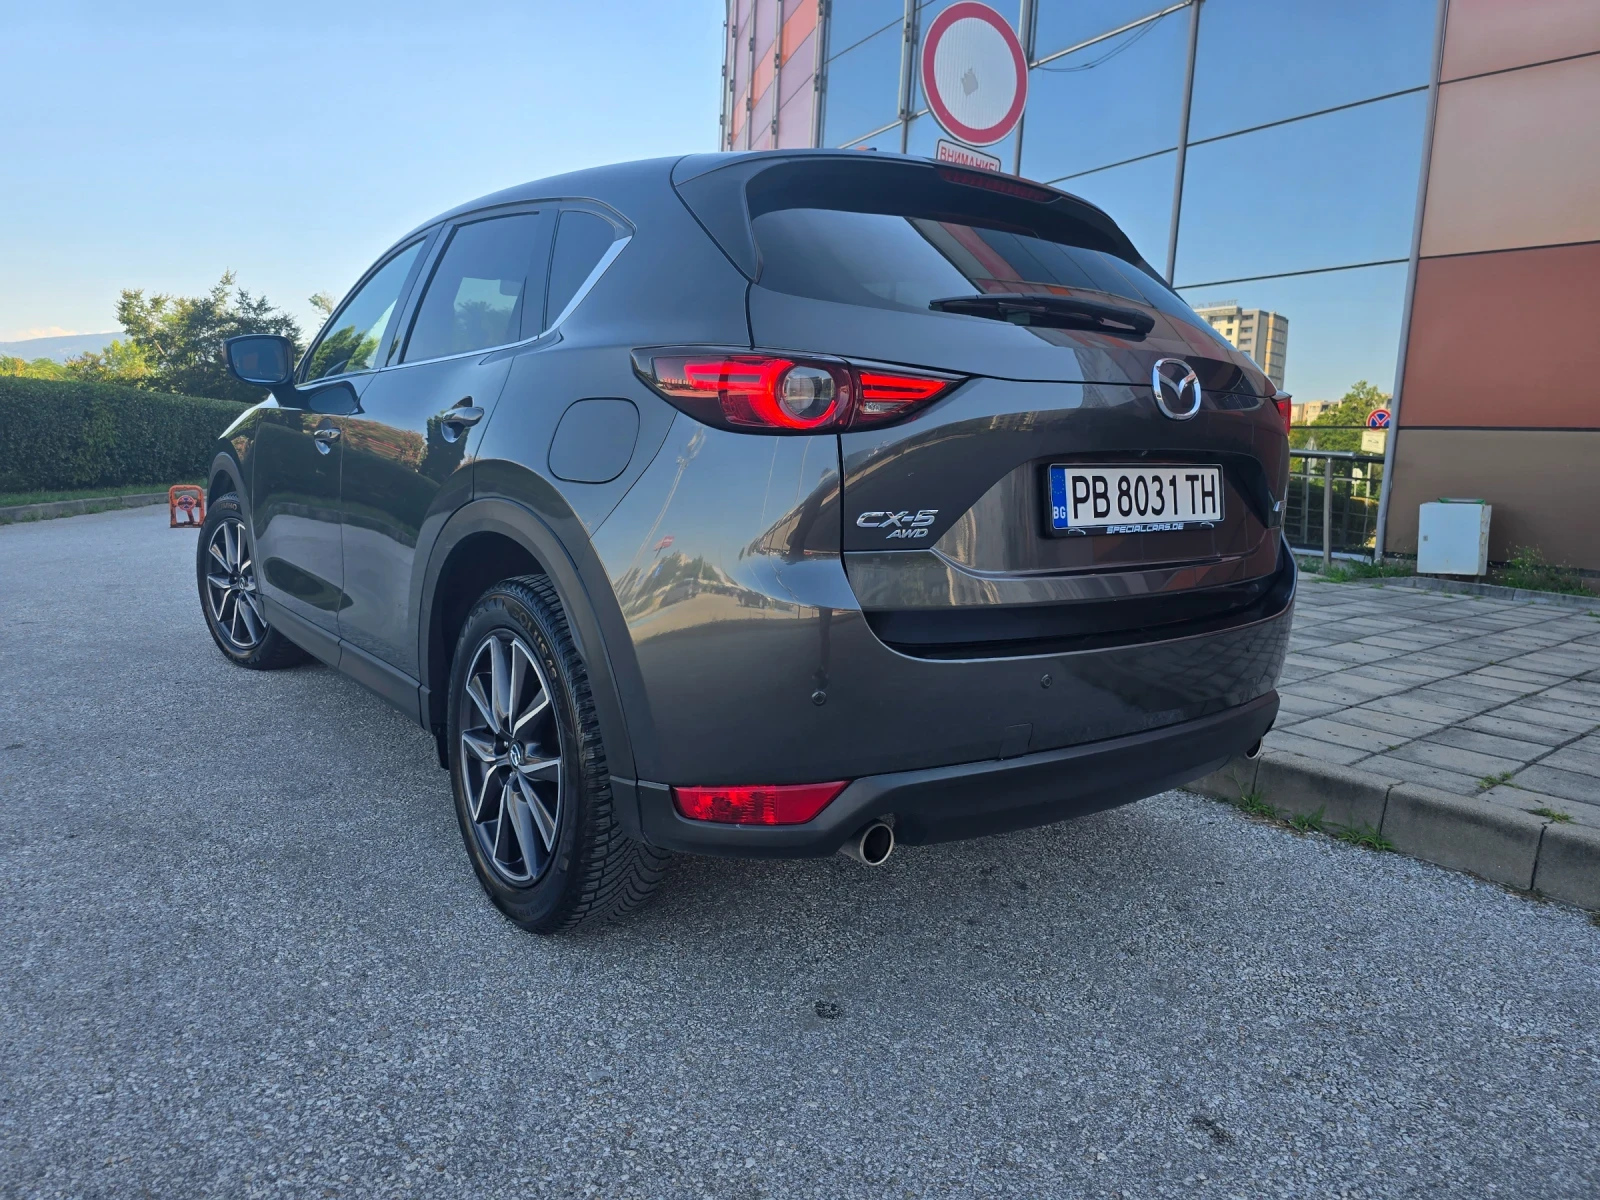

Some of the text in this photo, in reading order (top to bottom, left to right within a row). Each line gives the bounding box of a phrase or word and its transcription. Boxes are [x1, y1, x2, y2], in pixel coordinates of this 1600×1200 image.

[1071, 474, 1216, 520] PB 8031 TH
[856, 509, 939, 528] CX-5
[1053, 505, 1067, 520] BG
[885, 528, 929, 539] AWD
[1106, 522, 1184, 534] SPECIALCARS.DE
